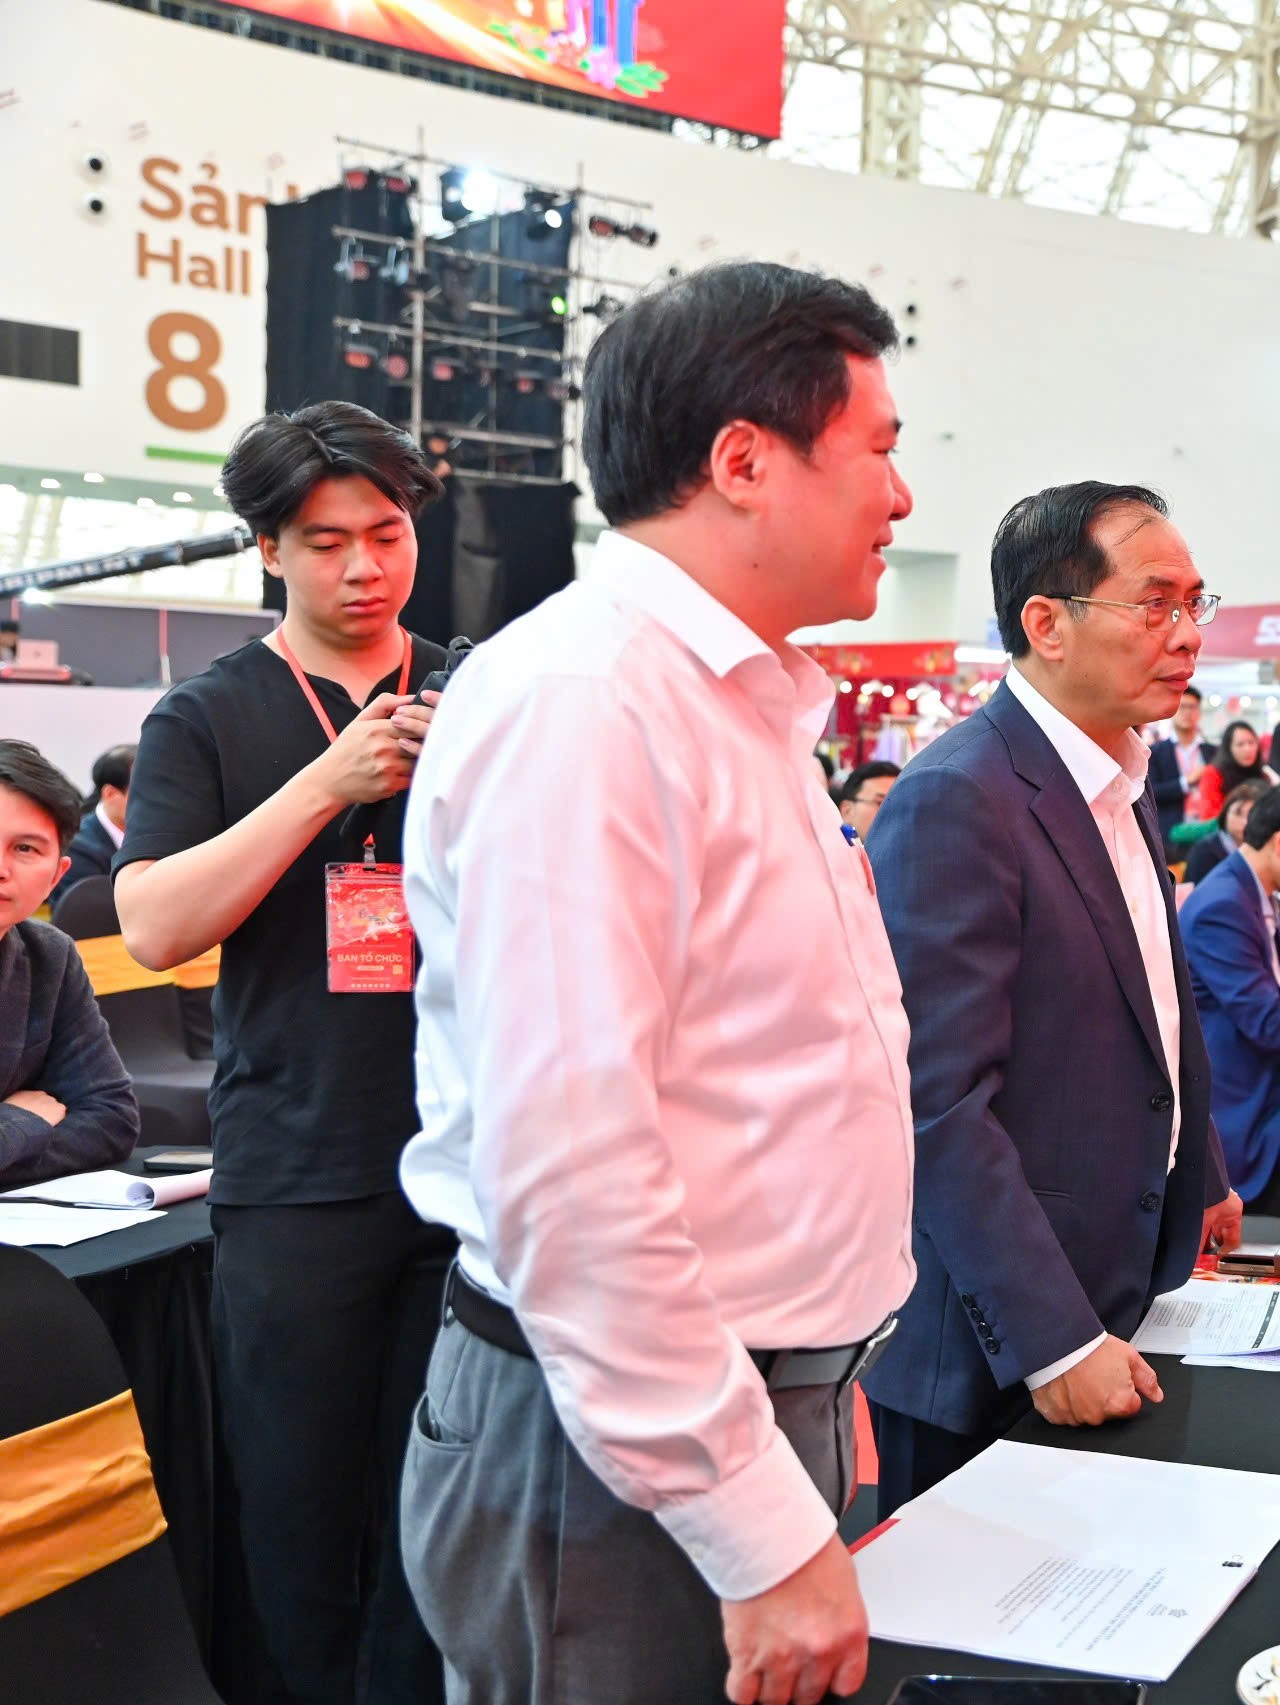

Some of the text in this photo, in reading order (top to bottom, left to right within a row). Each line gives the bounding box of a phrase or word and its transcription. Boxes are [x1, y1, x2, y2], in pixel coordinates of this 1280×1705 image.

[138, 156, 300, 236] Sản
[136, 232, 251, 296] Hall
[144, 311, 227, 432] 8
[337, 953, 358, 963] BAN
